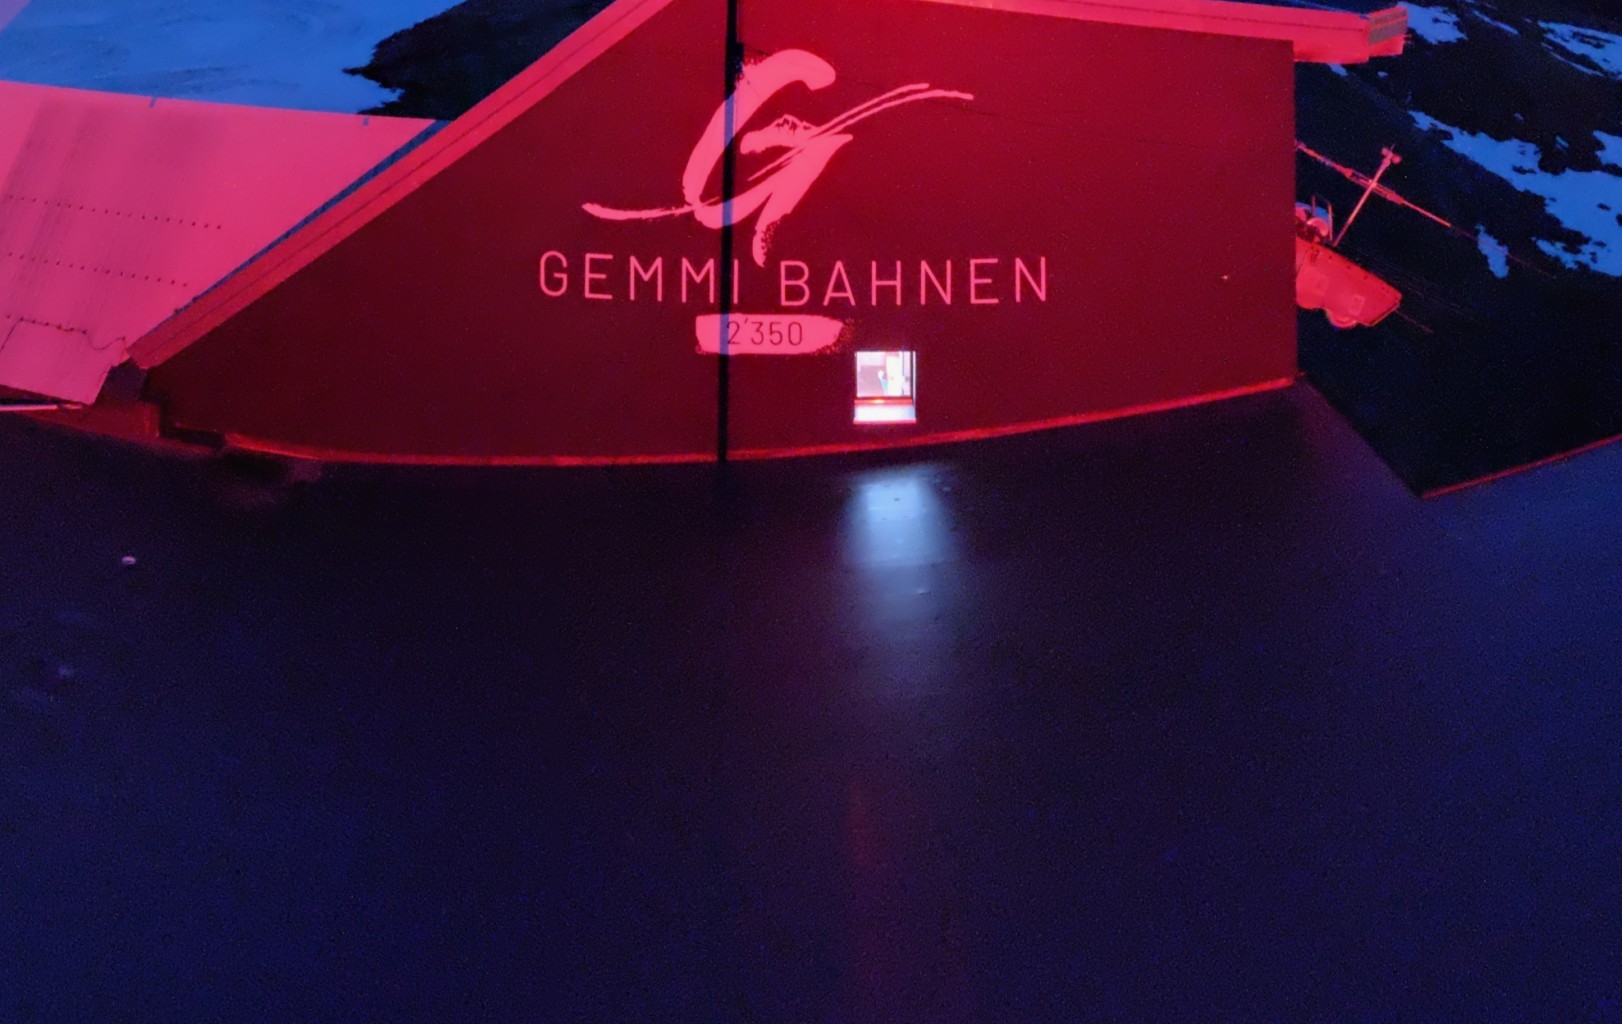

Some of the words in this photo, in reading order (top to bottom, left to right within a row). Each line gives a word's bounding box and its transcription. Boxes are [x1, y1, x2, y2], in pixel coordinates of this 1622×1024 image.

[539, 250, 740, 304] GEMMI
[779, 256, 1048, 307] BAHNEN
[726, 318, 804, 346] 2'350
